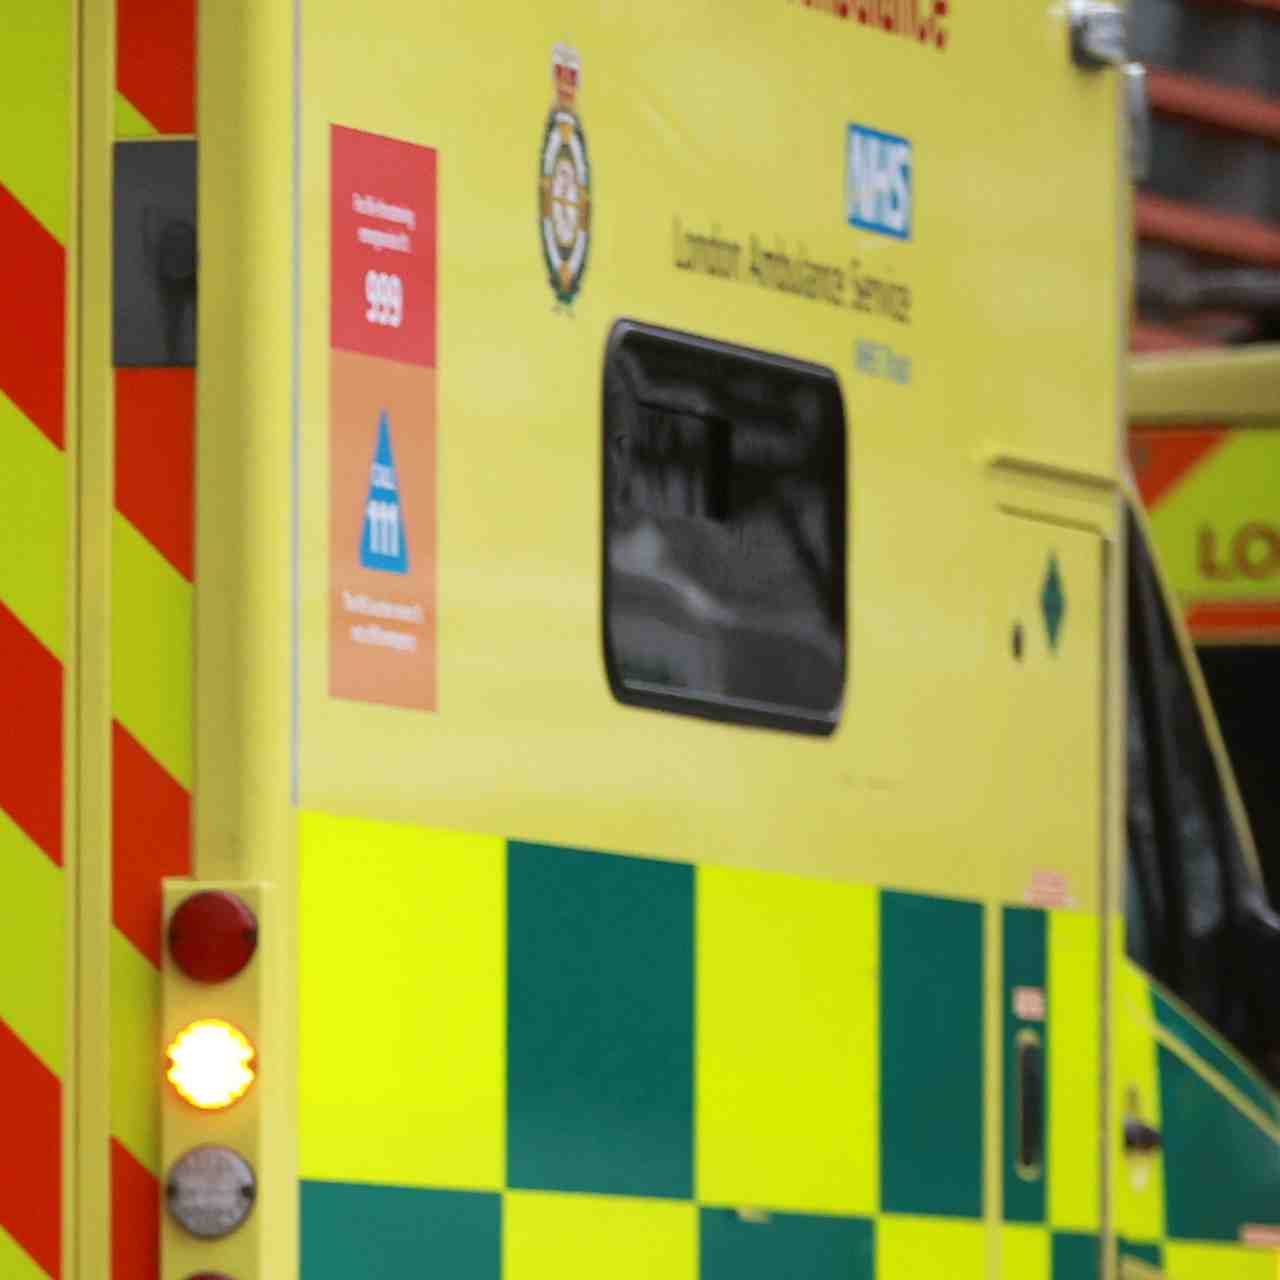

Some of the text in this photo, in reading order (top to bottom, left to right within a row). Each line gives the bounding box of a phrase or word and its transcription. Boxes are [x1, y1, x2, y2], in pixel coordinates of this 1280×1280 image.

[847, 128, 910, 236] NHS
[365, 268, 402, 327] 999
[673, 212, 913, 325] London Ambulance Service
[366, 499, 400, 558] 111
